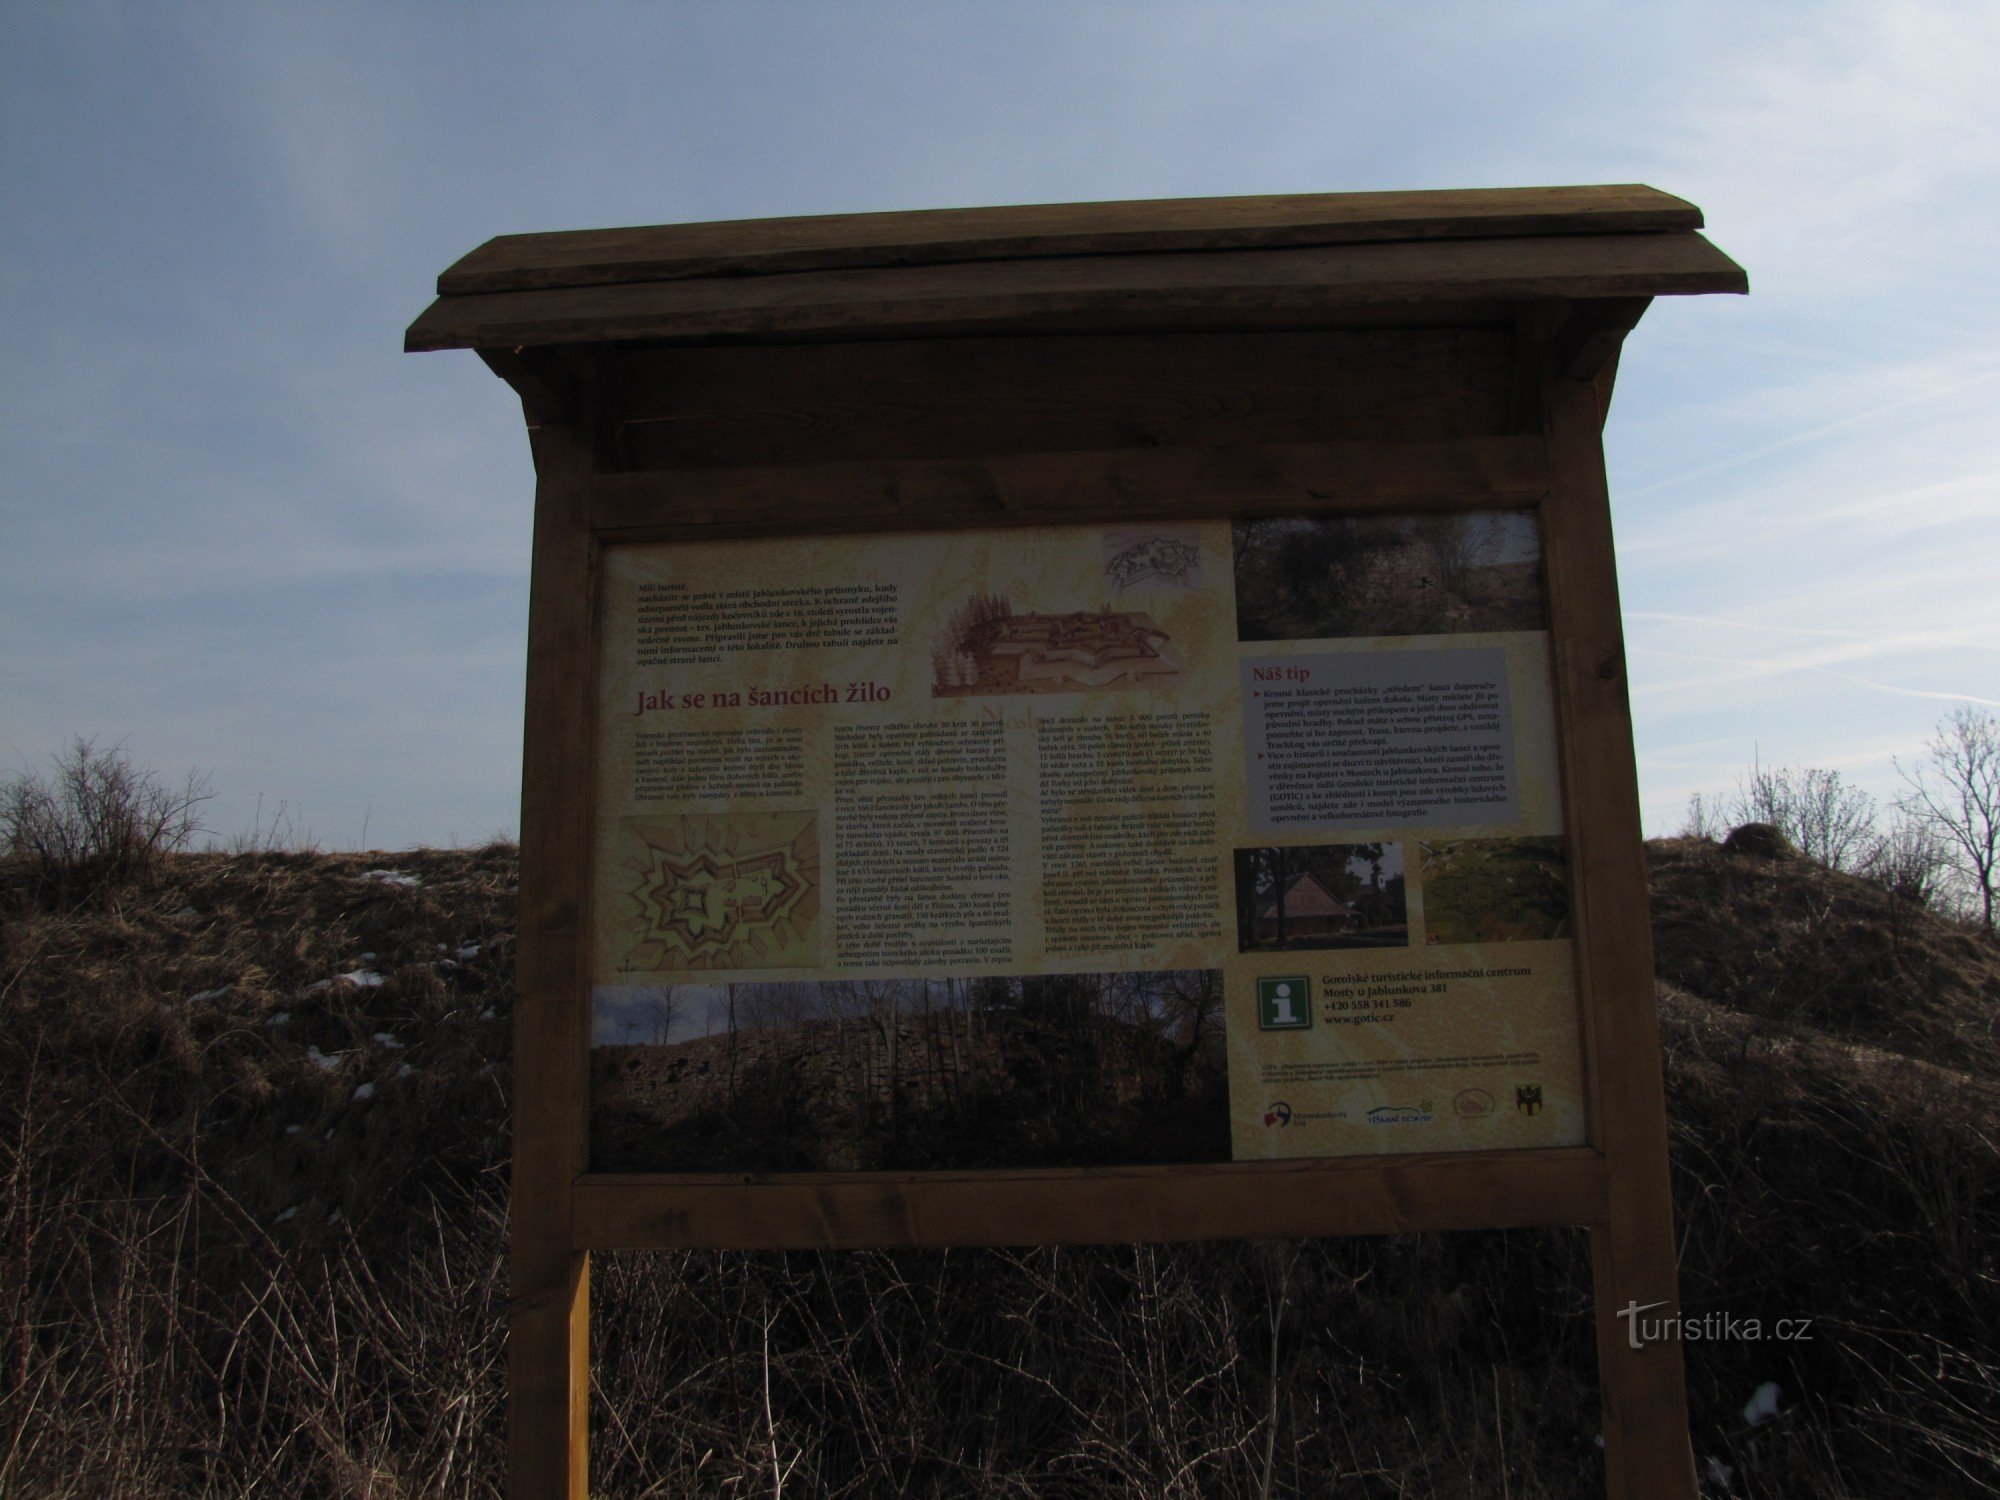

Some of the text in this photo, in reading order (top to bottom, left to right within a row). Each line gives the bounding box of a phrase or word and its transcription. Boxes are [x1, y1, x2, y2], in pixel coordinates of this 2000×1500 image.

[638, 593, 679, 602] nacházíte
[692, 592, 716, 601] právě
[726, 590, 751, 598] místě
[752, 587, 821, 598] Jablunkovského
[824, 584, 871, 595] průsmyku,
[874, 583, 896, 593] kudy
[657, 582, 687, 592] turisté,
[637, 603, 688, 613] odnepaměti
[691, 602, 712, 610] vedla
[715, 601, 736, 609] stará
[738, 599, 779, 608] obchodní
[782, 598, 812, 606] stezka.
[823, 596, 858, 604] ochraně
[861, 594, 897, 604] zdejšího
[637, 614, 664, 622] území
[666, 614, 685, 623] před
[688, 612, 719, 622] nájezdy
[721, 610, 766, 619] kočovníků
[769, 609, 783, 617] zde
[793, 608, 805, 616] 16.
[806, 607, 832, 615] století
[835, 606, 868, 615] vyrostla
[871, 606, 897, 614] vojen-
[654, 624, 686, 634] pevnost
[696, 623, 711, 631] tzv.
[713, 621, 770, 631] jablunkovské
[772, 619, 798, 629] šance,
[809, 618, 836, 627] jejichž
[839, 616, 882, 626] prohlídce
[883, 615, 897, 623] vás
[637, 635, 670, 643] srdečně
[705, 632, 745, 642] Připravili
[805, 629, 820, 637] dvě
[822, 628, 851, 636] tabule
[865, 626, 897, 634] základ-
[637, 646, 657, 654] ními
[660, 644, 715, 653] informacemi
[746, 641, 782, 650] lokalitě.
[785, 640, 819, 648] Druhou
[822, 638, 848, 646] tabuli
[851, 637, 883, 647] najdete
[636, 654, 722, 666] opačné straně šancí.
[1252, 666, 1310, 683] Náš tip
[1263, 689, 1292, 697] Kromě
[1333, 686, 1378, 695] procházky
[1381, 684, 1424, 694] „středem“
[1453, 681, 1497, 691] doporuču-
[634, 681, 890, 715] Jak se na šancích žilo
[1286, 699, 1310, 708] projít
[1312, 697, 1351, 707] opevnění
[1353, 696, 1380, 704] kolem
[1382, 695, 1413, 703] dokola.
[1416, 694, 1439, 703] Místy
[1441, 692, 1472, 700] můžete
[1474, 692, 1484, 700] jít
[1264, 720, 1300, 729] původní
[1302, 718, 1334, 727] hradby.
[1336, 717, 1364, 725] Pokud
[1366, 716, 1388, 724] máte
[1422, 713, 1454, 723] přístroj
[1456, 713, 1475, 721] GPS,
[1266, 737, 1388, 750] TrackLog vás určitě překvapí.
[1267, 751, 1285, 759] Více
[1293, 750, 1324, 758] historii
[1275, 781, 1313, 789] dřevěnce
[1316, 780, 1334, 788] sídlí
[1336, 779, 1374, 787] Gorolské
[1468, 774, 1504, 782] centrum
[1270, 803, 1305, 812] umělců,
[1307, 801, 1339, 810] najdete
[1270, 813, 1309, 822] opevnění
[1322, 966, 1531, 984] Gorolské turistické informační centrum
[1323, 987, 1353, 998] Mosty
[1367, 984, 1426, 996] Jablunkova
[1430, 984, 1446, 992] 381
[1324, 998, 1411, 1010] +420 558 341 586
[1324, 1012, 1393, 1025] www.gotic.cz
